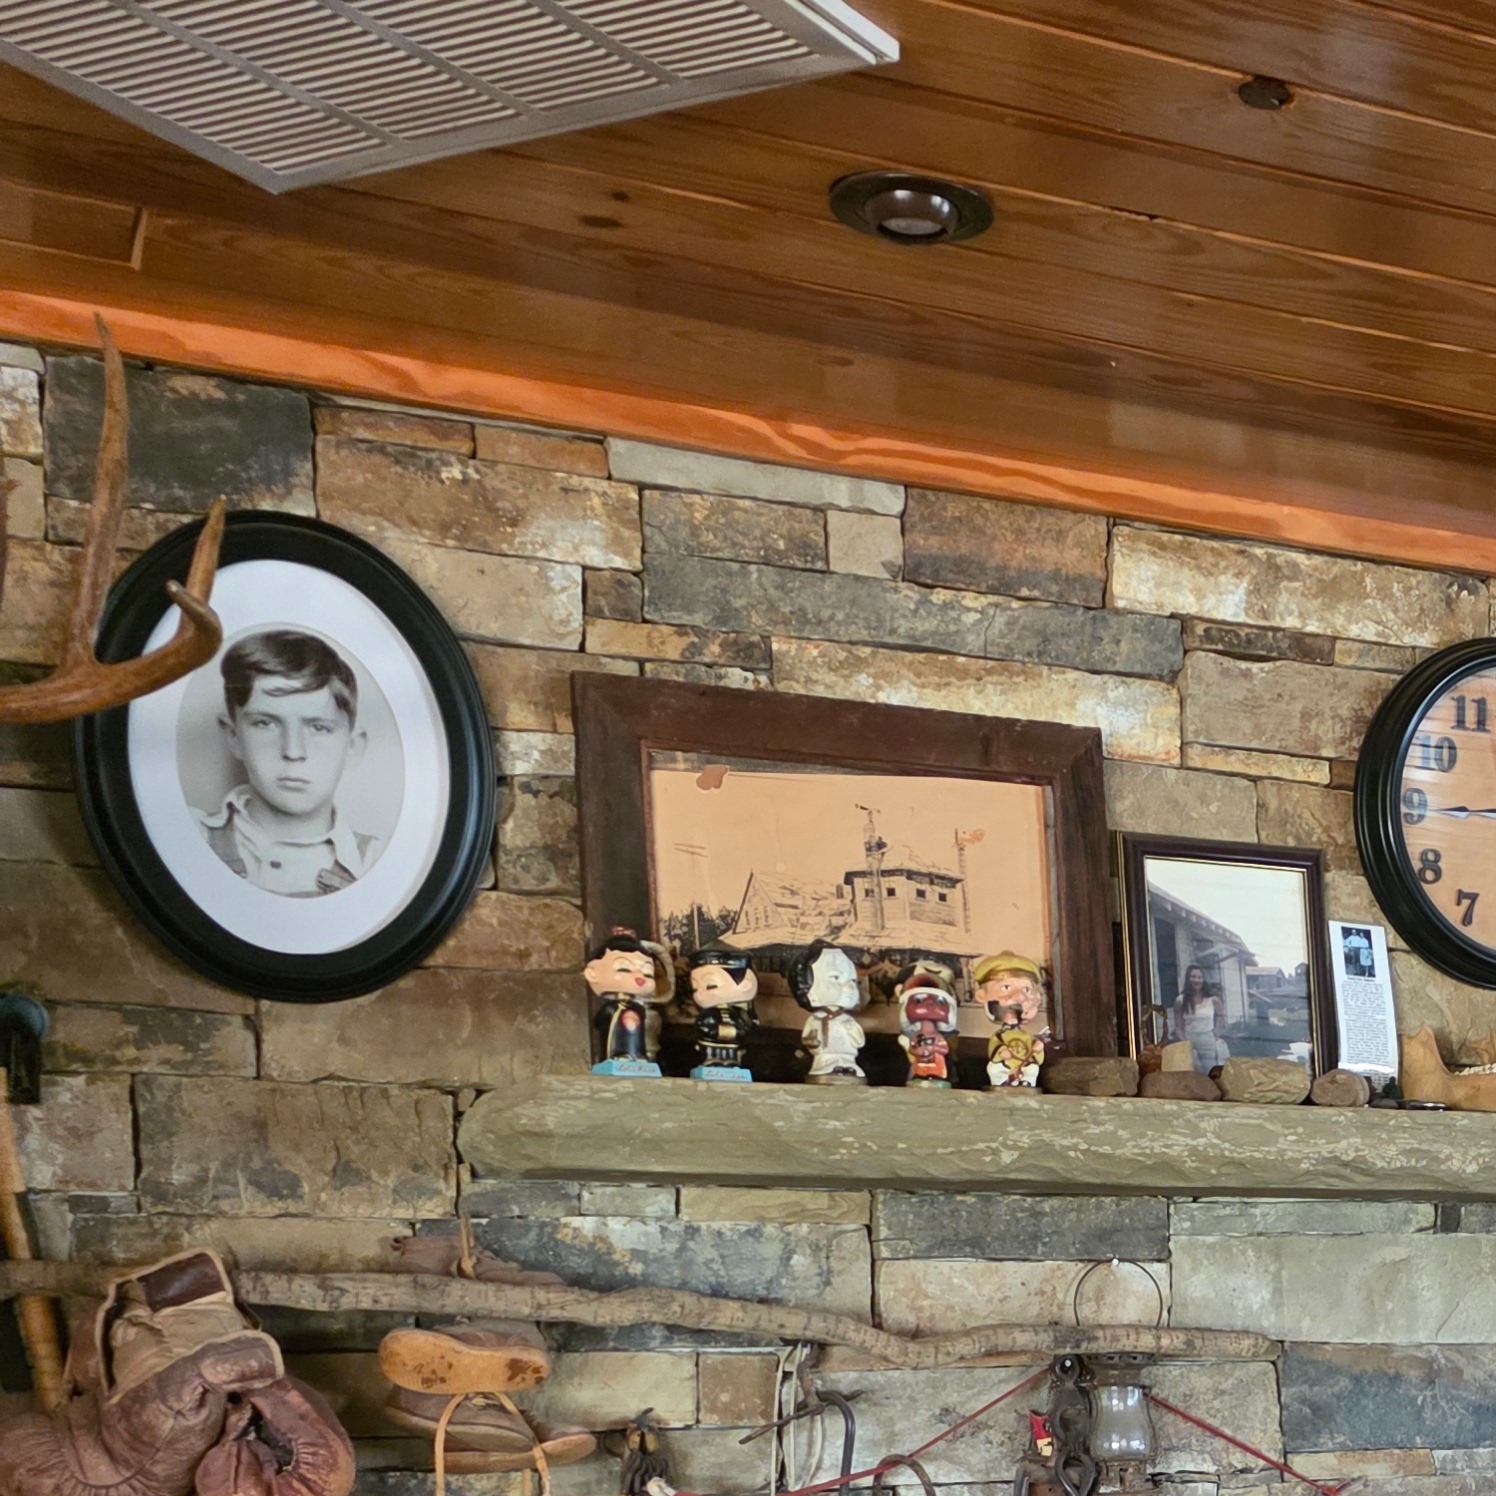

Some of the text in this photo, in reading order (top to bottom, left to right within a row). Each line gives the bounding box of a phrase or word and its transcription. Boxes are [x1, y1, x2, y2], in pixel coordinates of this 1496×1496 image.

[1450, 695, 1491, 733] 11
[1416, 735, 1458, 772] 10
[1403, 787, 1428, 825] 9
[1419, 849, 1443, 885] 8
[1456, 889, 1479, 927] 7
